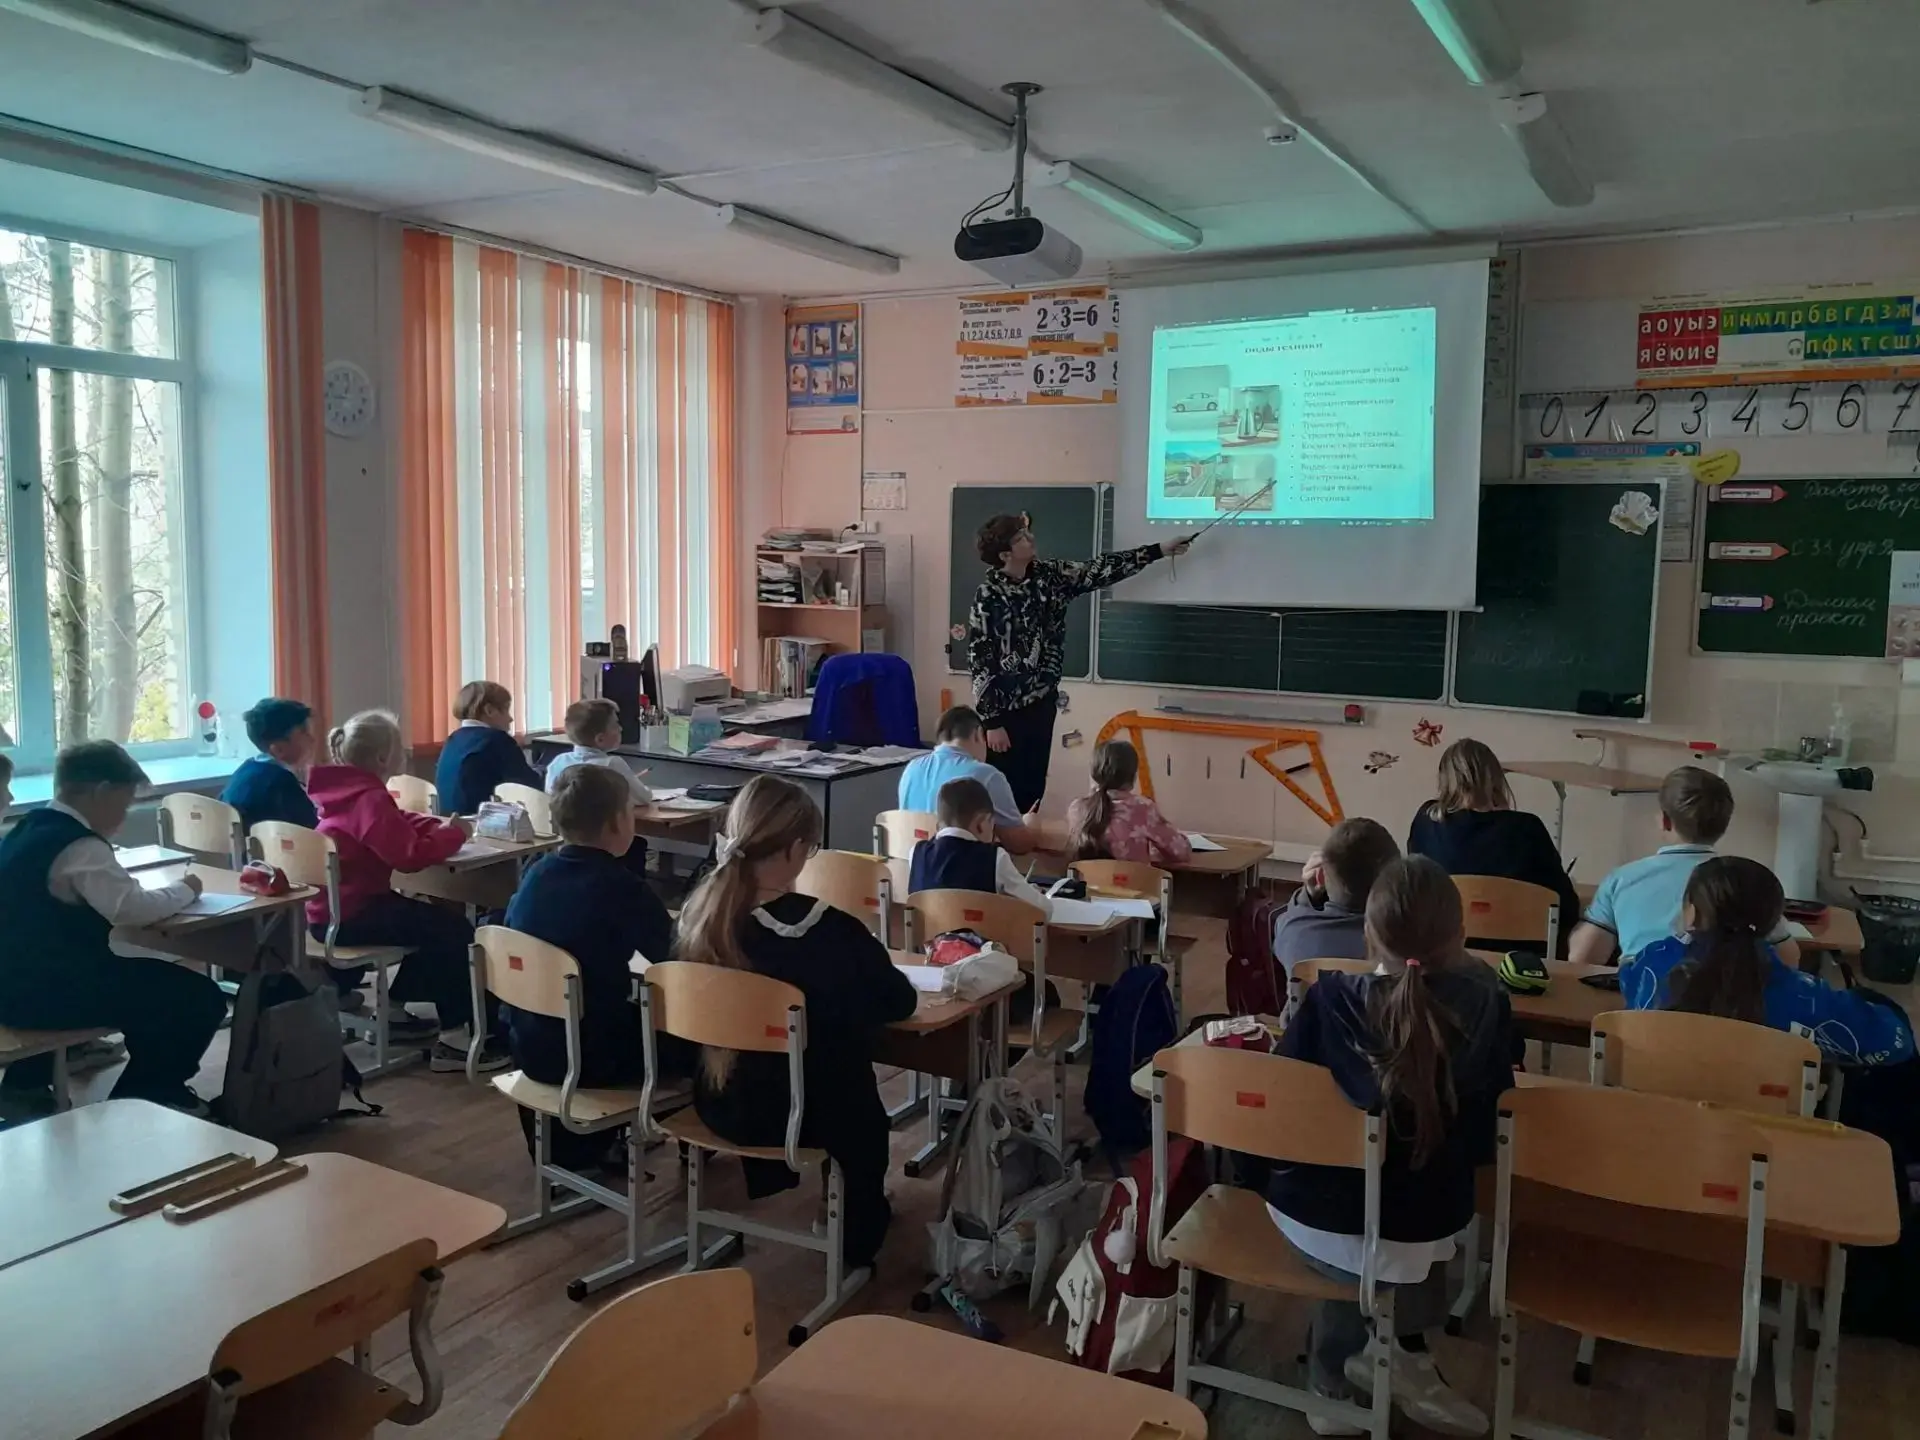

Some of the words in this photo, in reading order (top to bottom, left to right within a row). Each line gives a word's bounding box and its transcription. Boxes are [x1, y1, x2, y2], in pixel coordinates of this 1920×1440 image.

[1540, 396, 1563, 438] 0
[1584, 395, 1609, 438] 1
[1632, 393, 1656, 436] 2
[1681, 391, 1707, 435] 3
[1732, 388, 1759, 432] 4
[1782, 387, 1811, 430] 5
[1837, 384, 1865, 428] 6
[1892, 382, 1920, 428] 7
